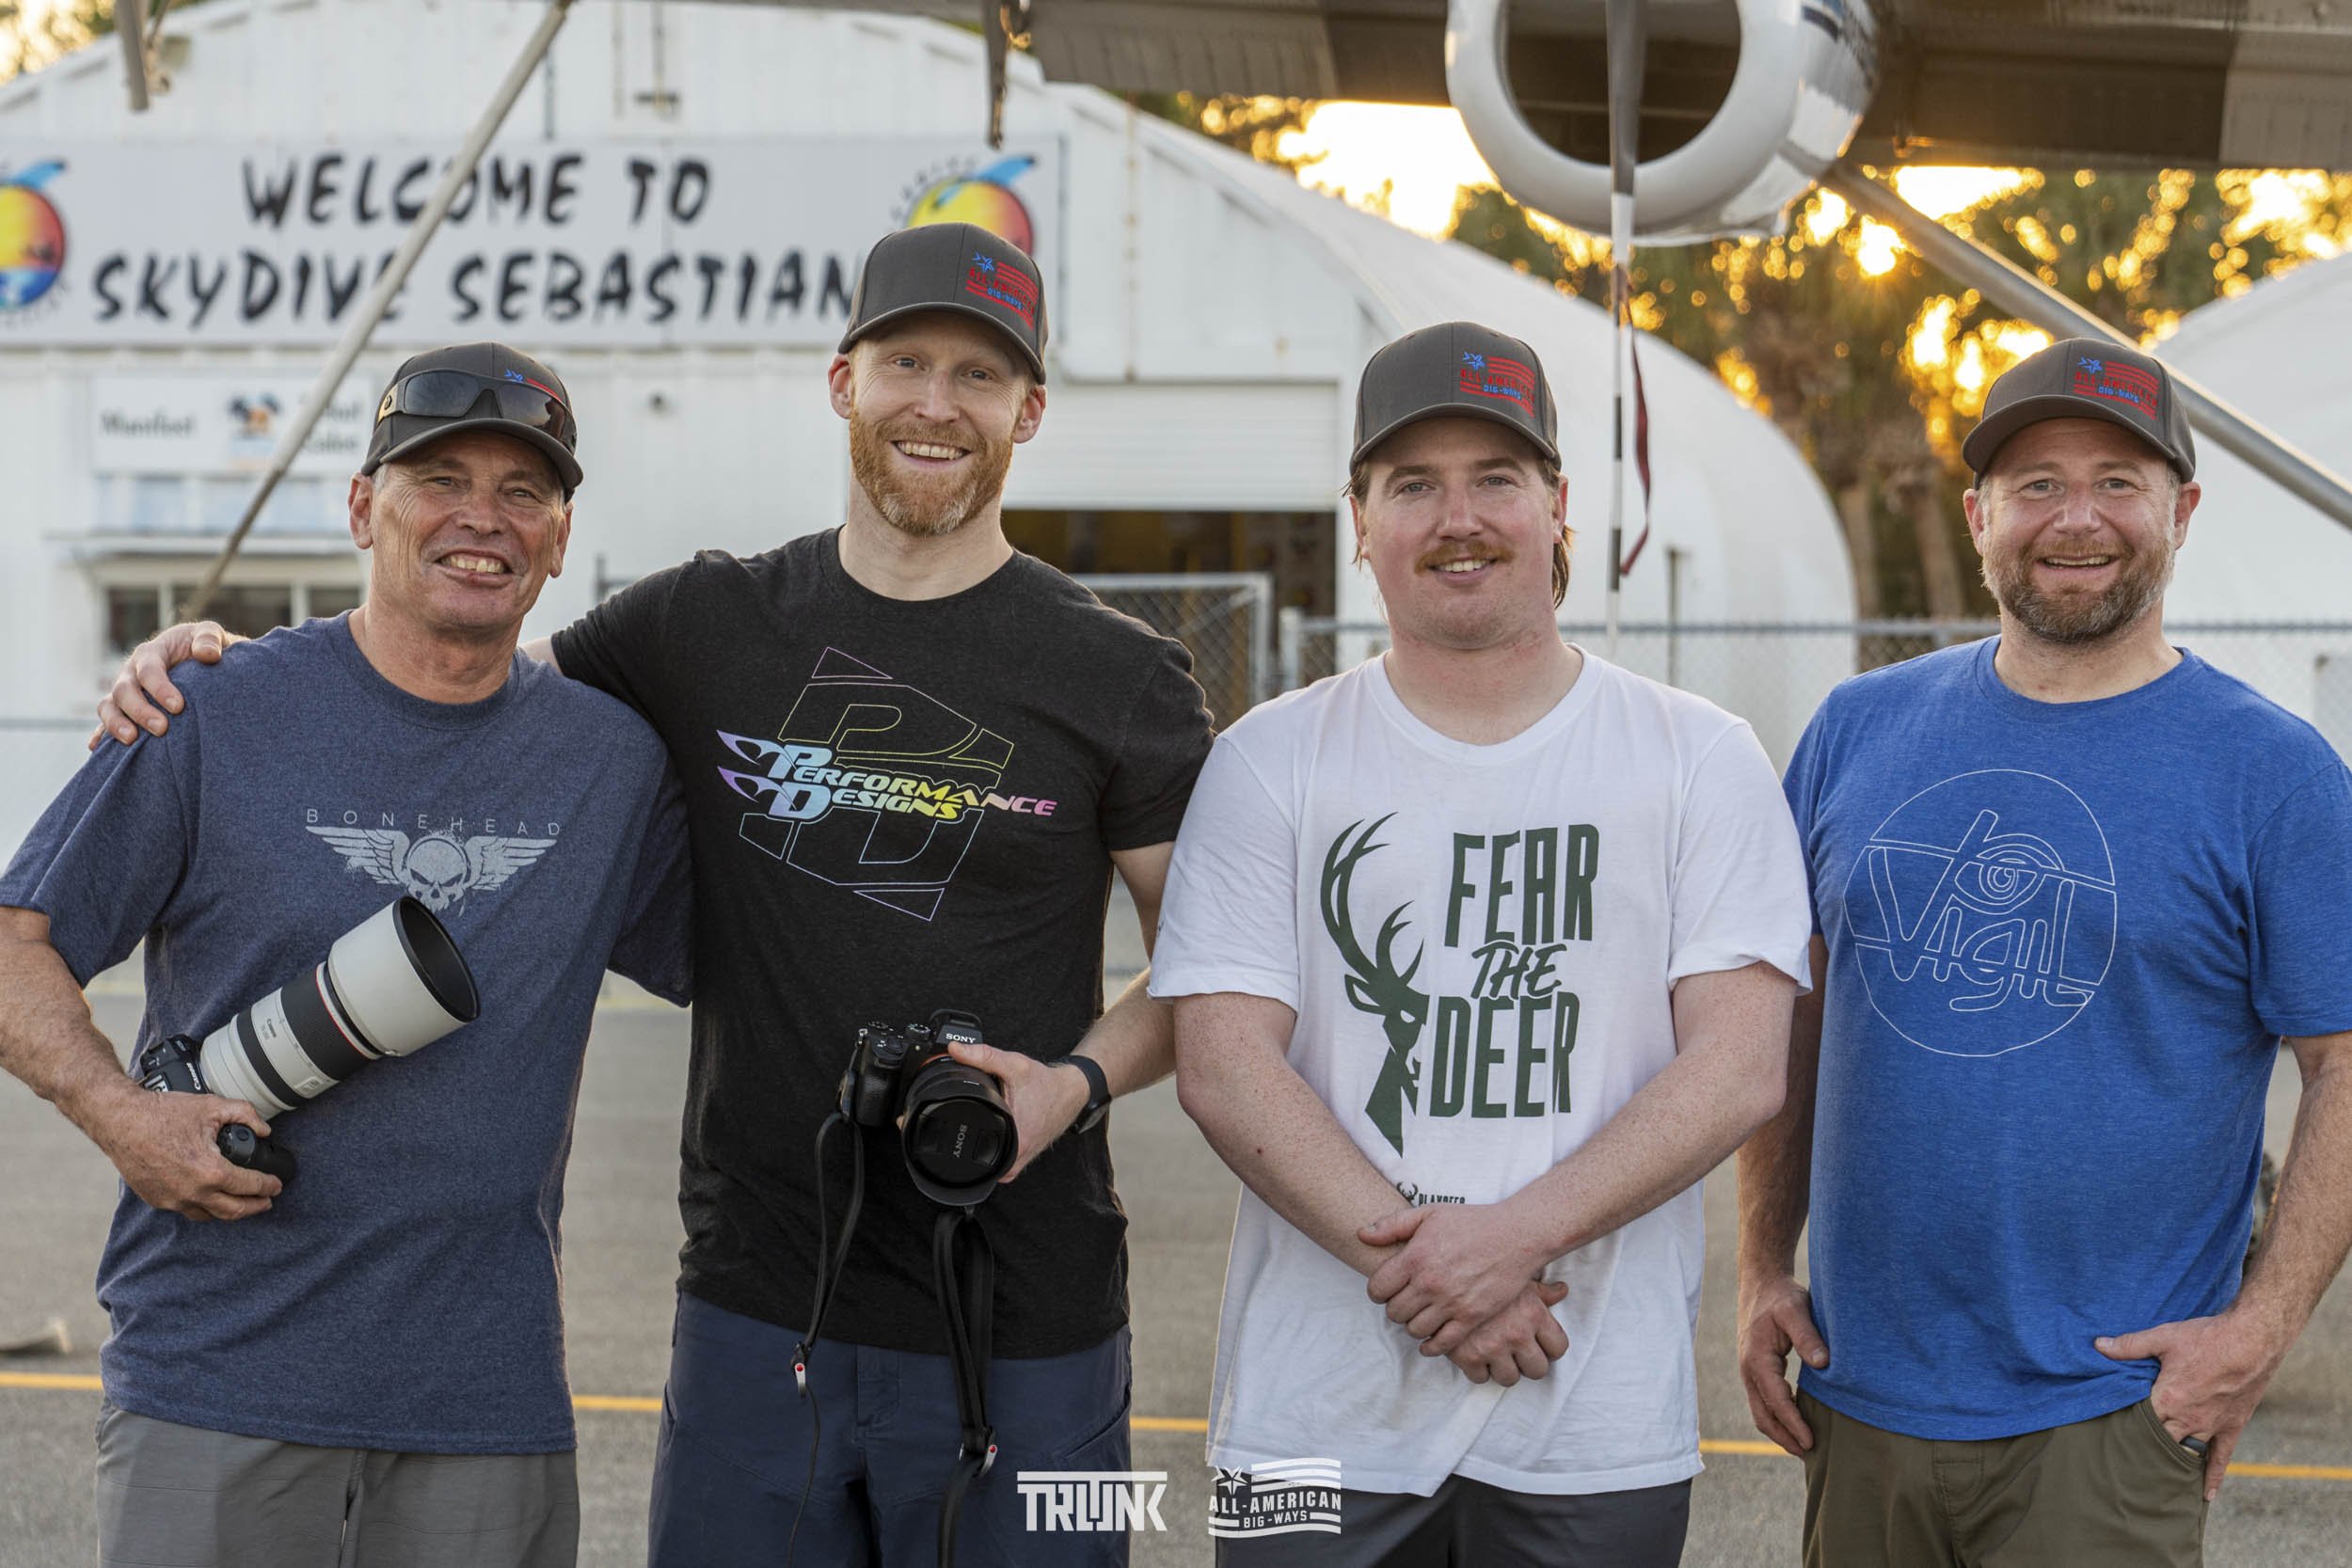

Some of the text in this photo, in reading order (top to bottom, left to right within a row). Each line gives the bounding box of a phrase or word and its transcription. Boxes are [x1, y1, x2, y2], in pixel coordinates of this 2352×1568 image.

[241, 152, 710, 229] WELCOME TO
[452, 248, 859, 324] SEBASTIAN
[306, 809, 561, 836] BONEHEAD
[1444, 824, 1599, 948] FEAR
[1471, 942, 1567, 1000] THE
[946, 1033, 976, 1044] SONY
[1429, 991, 1581, 1118] DEER
[953, 1124, 968, 1159] SONY
